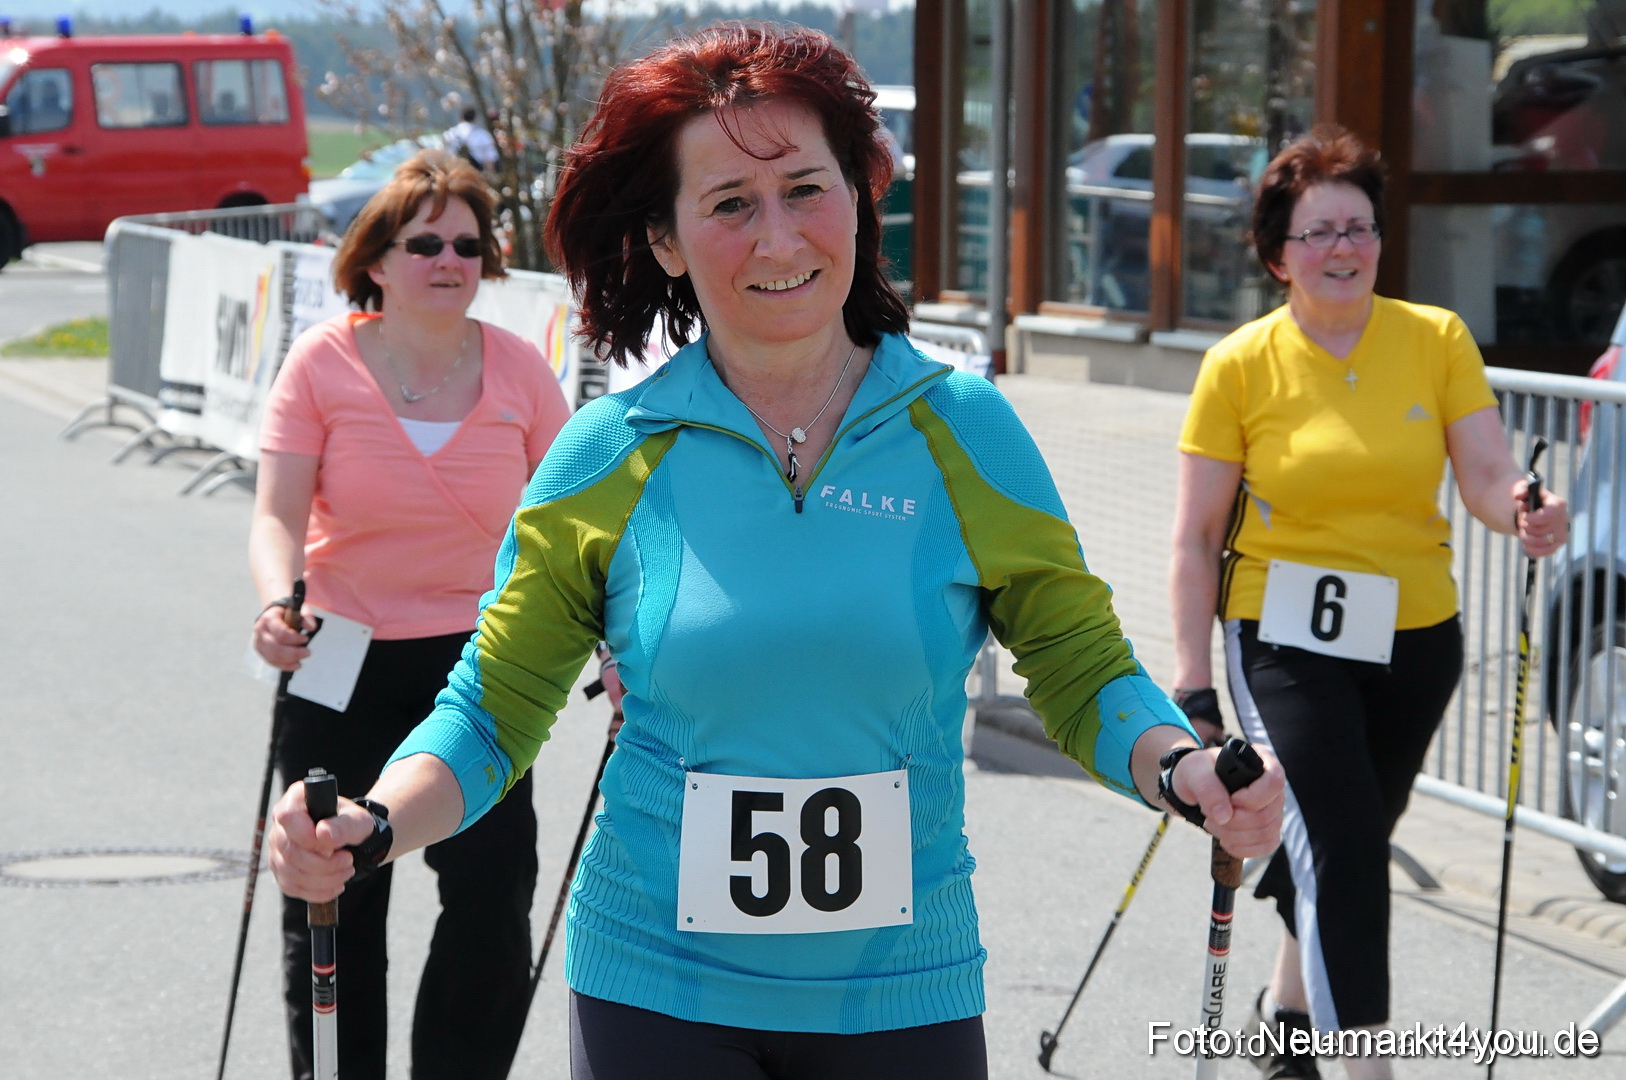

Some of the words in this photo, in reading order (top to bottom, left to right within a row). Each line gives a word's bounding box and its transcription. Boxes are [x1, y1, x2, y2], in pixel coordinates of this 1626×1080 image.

[820, 484, 916, 515] FALKE
[825, 501, 861, 514] ERGONOMIC
[864, 509, 882, 518] SPORT
[884, 513, 906, 521] SYSTEM
[1310, 574, 1347, 642] 6
[729, 786, 863, 917] 58
